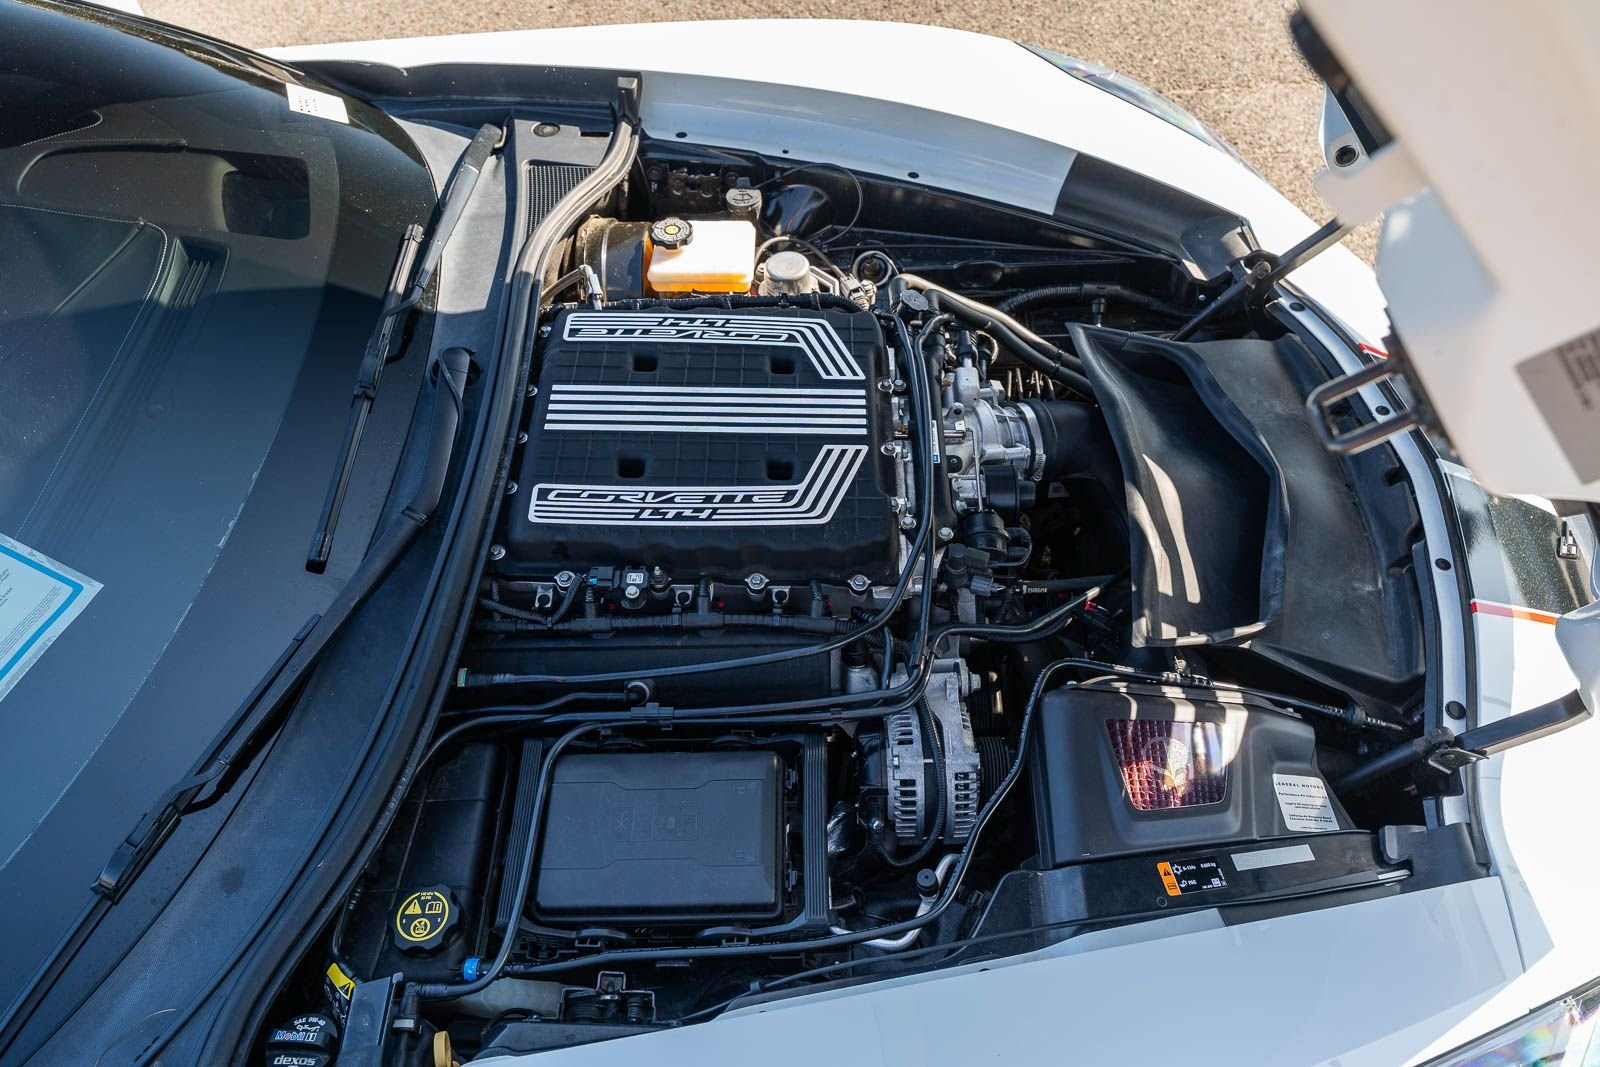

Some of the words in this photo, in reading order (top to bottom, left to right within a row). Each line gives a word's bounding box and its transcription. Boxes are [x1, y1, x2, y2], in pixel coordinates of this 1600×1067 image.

[662, 318, 728, 327] LT4
[575, 328, 790, 341] CORVETTE
[547, 489, 789, 503] CORVETTE
[638, 507, 713, 519] LT4
[275, 1030, 305, 1041] Mobil
[274, 1055, 316, 1066] dexos
